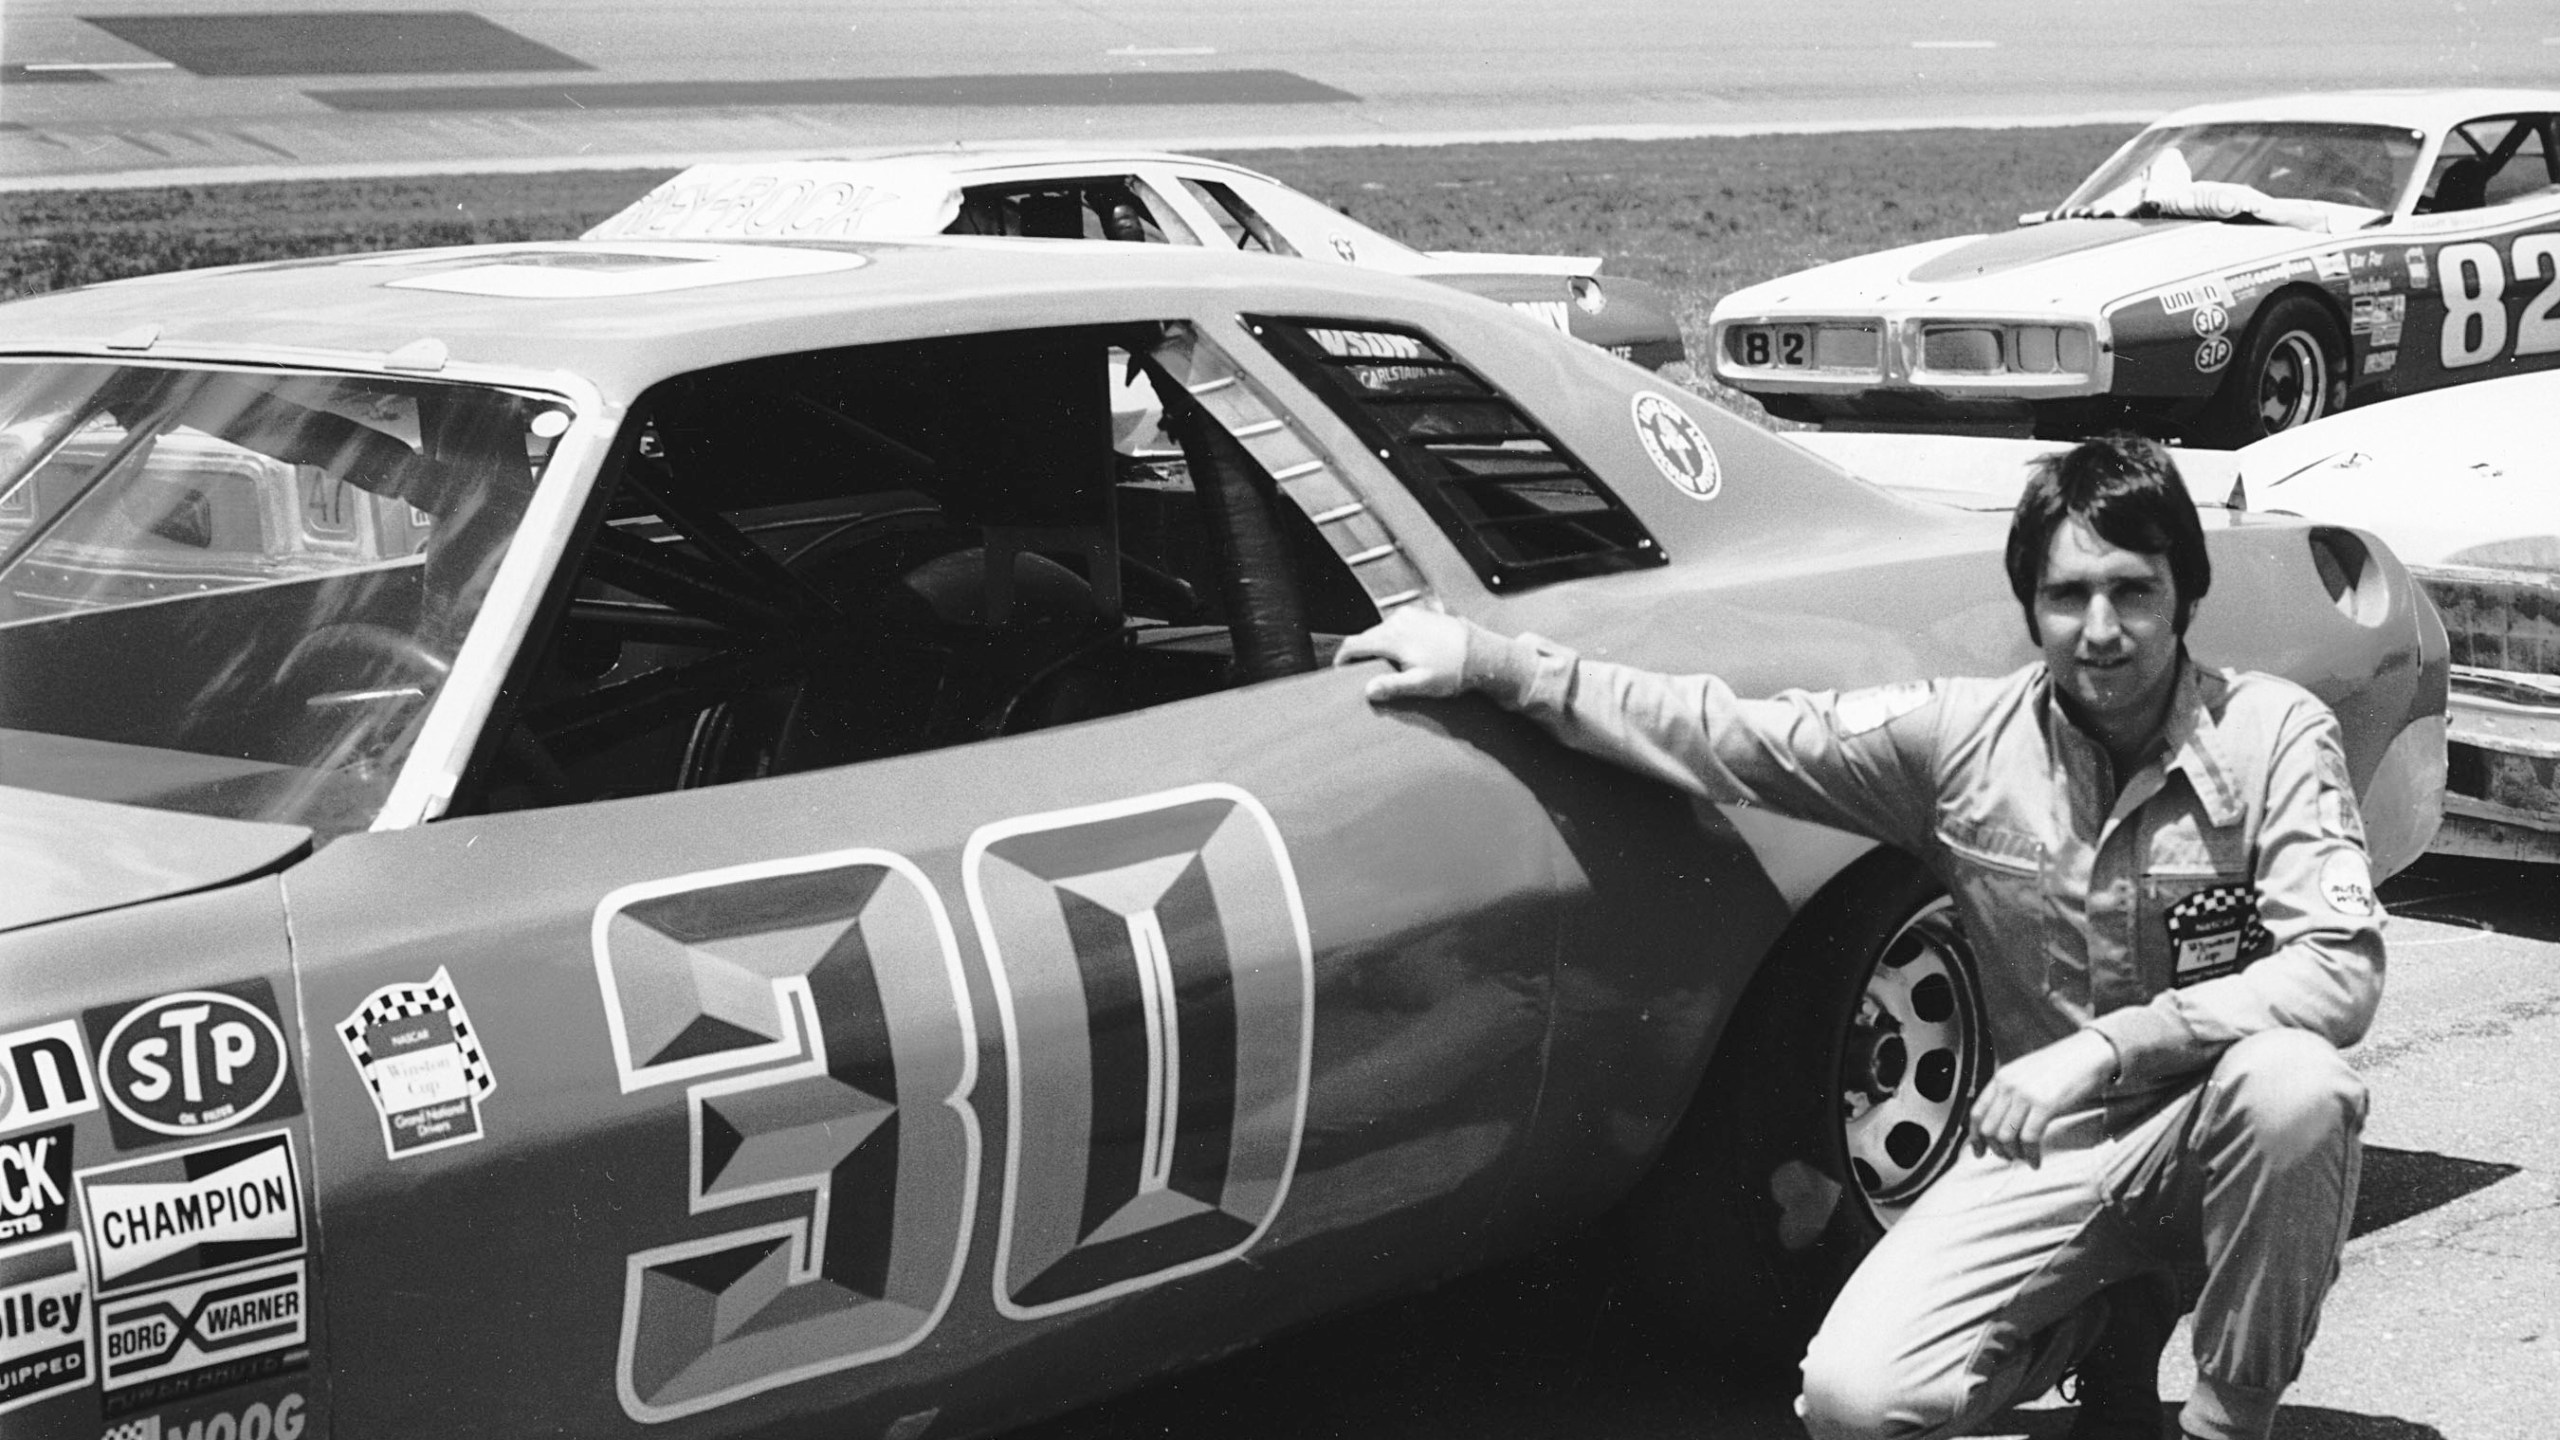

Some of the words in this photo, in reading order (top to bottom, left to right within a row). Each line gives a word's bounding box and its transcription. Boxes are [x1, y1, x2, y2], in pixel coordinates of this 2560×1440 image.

[2197, 306, 2224, 332] STP
[2437, 231, 2560, 369] 82
[1746, 332, 1804, 366] 82
[2200, 340, 2228, 366] STP
[128, 1004, 257, 1102] STP
[592, 783, 1314, 1425] 30
[0, 1137, 65, 1216] CK
[102, 1174, 288, 1250] CHAMPION
[0, 1291, 83, 1338] lley
[107, 1321, 167, 1359] BORG
[206, 1290, 300, 1335] WARNER
[0, 1352, 81, 1391] UIPPED
